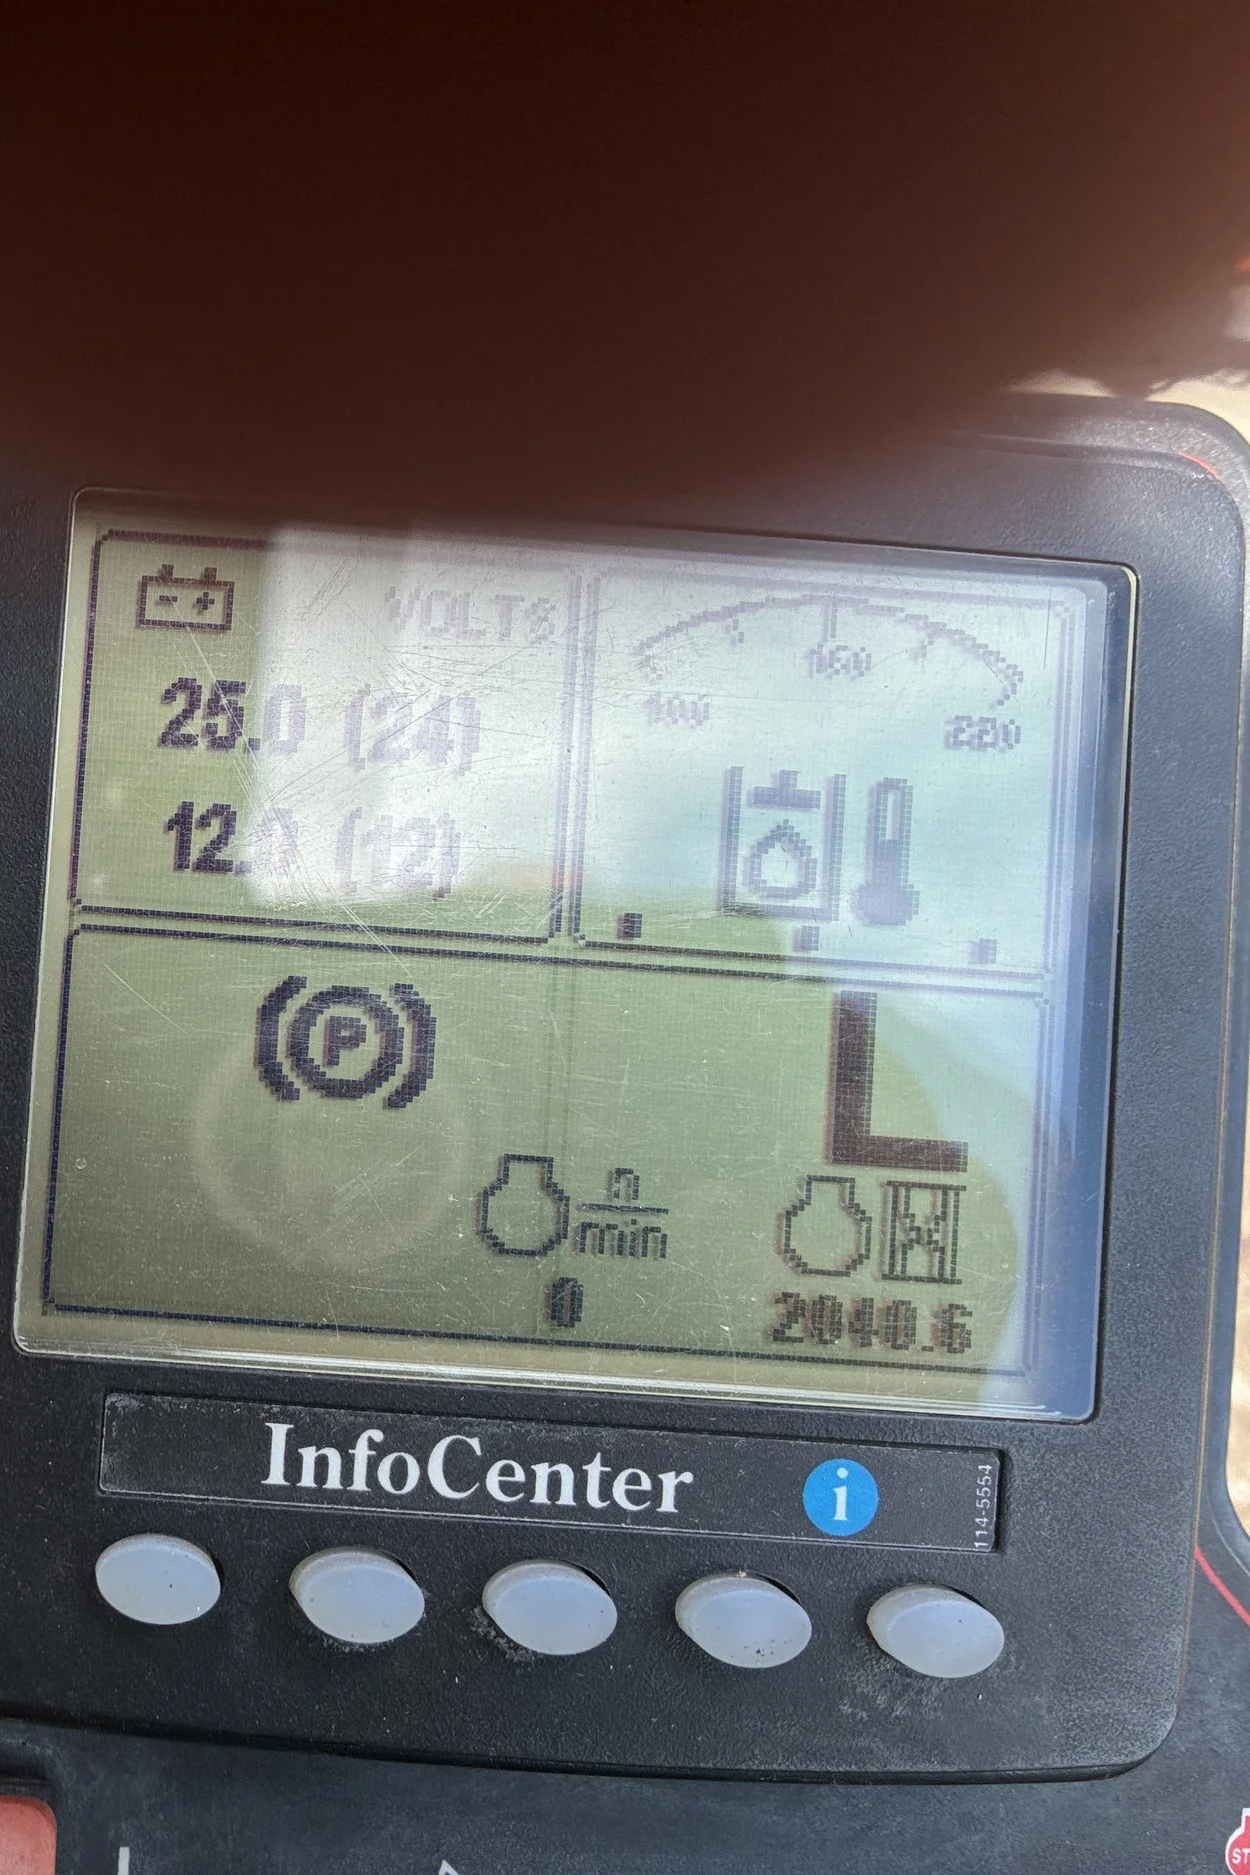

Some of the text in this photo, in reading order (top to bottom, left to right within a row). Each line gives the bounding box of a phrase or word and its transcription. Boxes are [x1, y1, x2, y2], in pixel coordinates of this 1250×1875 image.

[160, 677, 307, 754] 25.0
[950, 714, 1021, 750] 220
[323, 1016, 366, 1067] P
[831, 990, 968, 1172] L
[578, 1218, 668, 1258] min
[772, 1291, 973, 1353] 2040.6
[261, 1422, 693, 1513] InfoCenter
[973, 1464, 993, 1549] 114-5554
